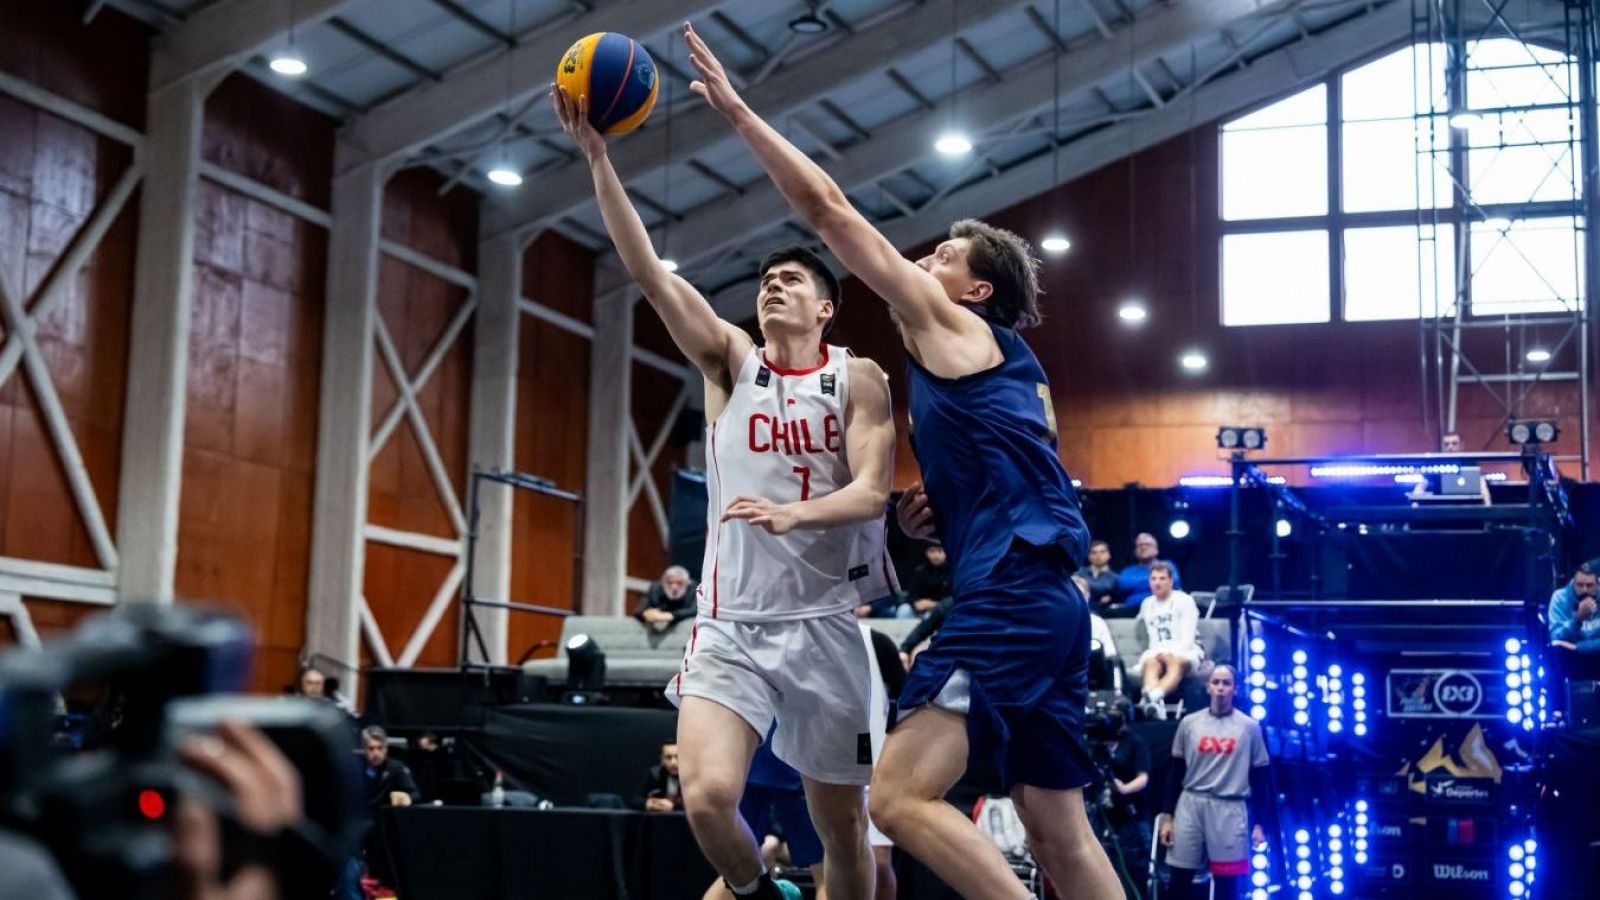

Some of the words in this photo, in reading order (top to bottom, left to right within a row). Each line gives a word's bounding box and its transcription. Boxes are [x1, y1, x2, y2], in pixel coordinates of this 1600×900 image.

[748, 413, 840, 456] CHILE
[793, 466, 810, 502] 7
[1433, 864, 1489, 879] Wilson
